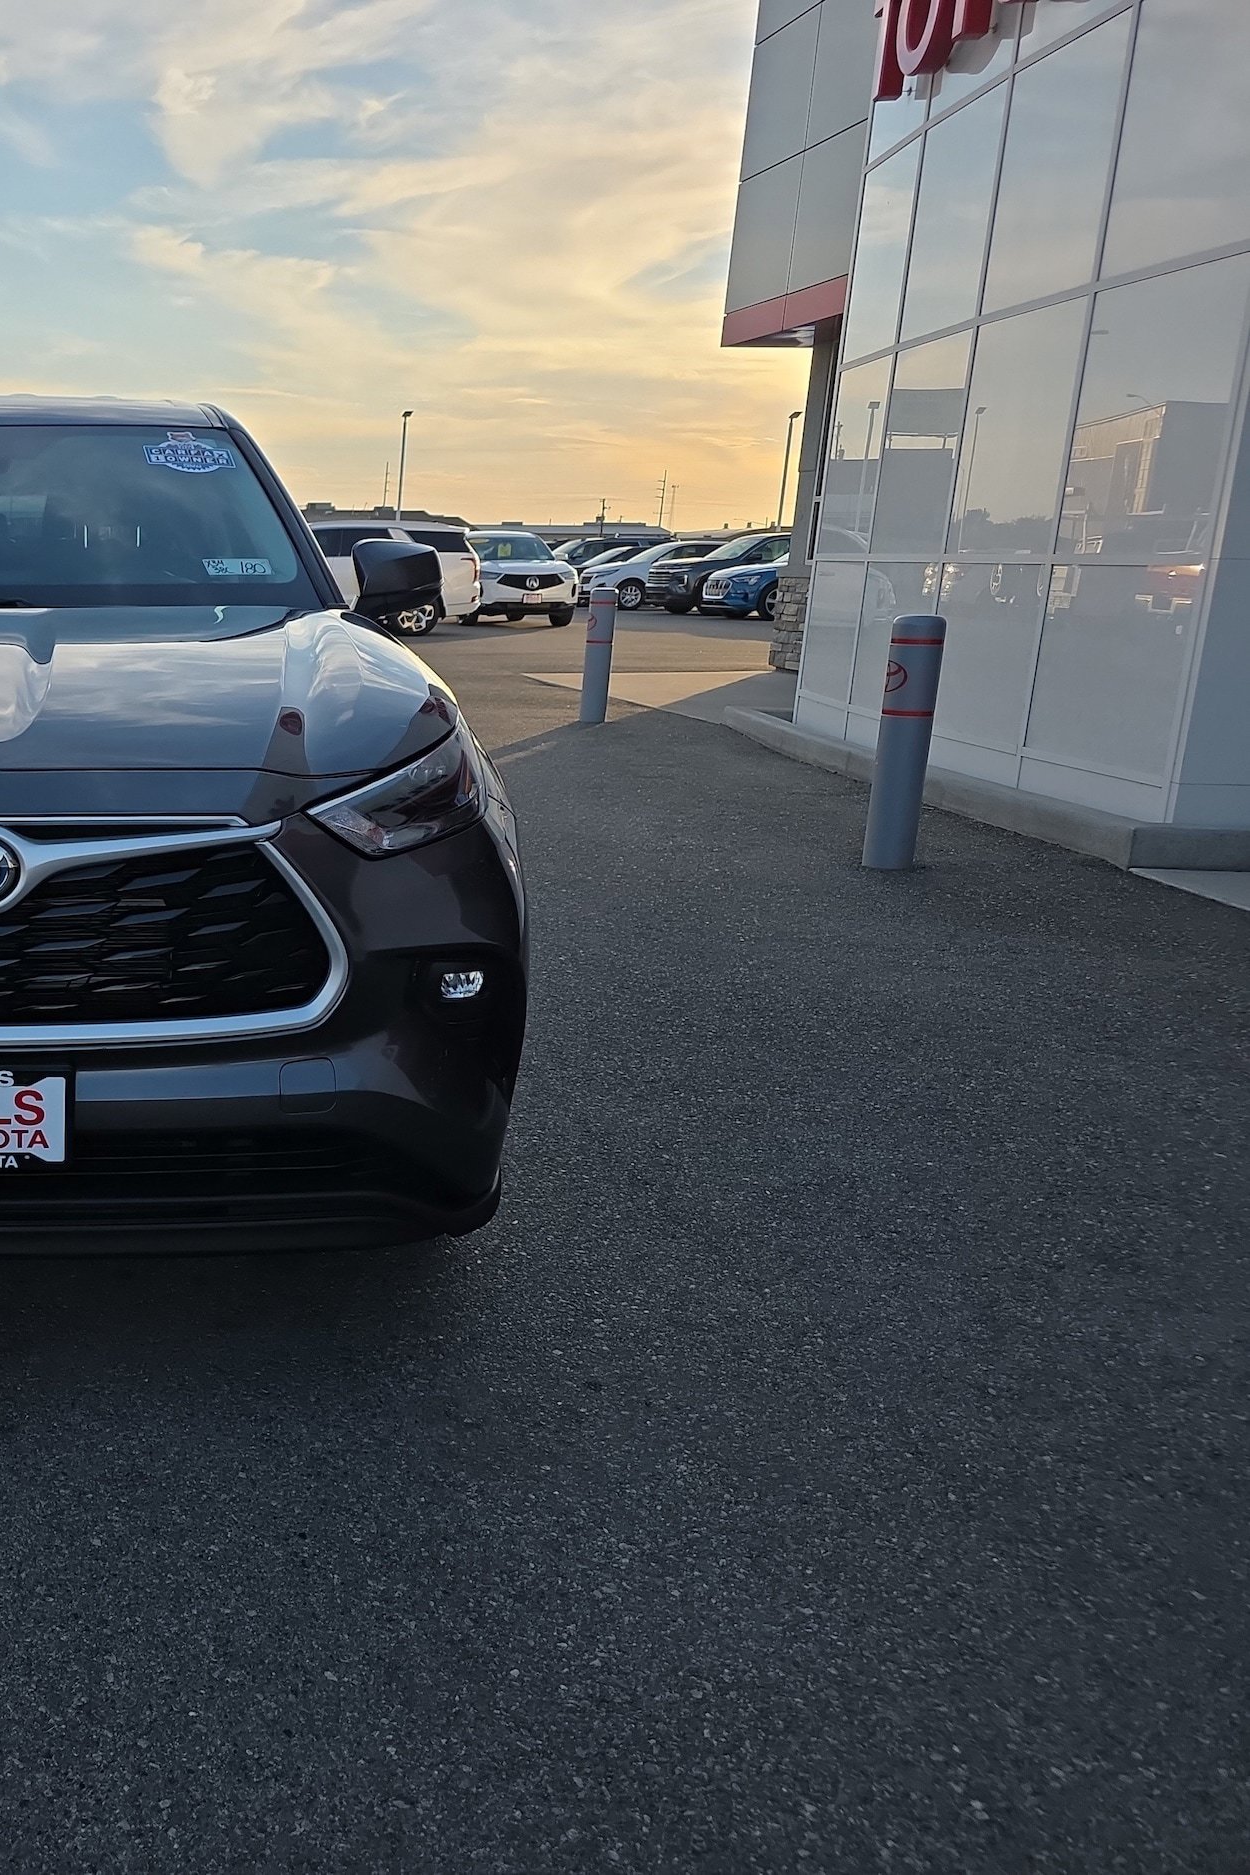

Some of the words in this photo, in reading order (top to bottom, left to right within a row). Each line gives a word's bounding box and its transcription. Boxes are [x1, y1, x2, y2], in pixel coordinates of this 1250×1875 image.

[151, 447, 227, 459] CARFAX
[166, 455, 228, 465] OWNER
[240, 561, 267, 574] 180
